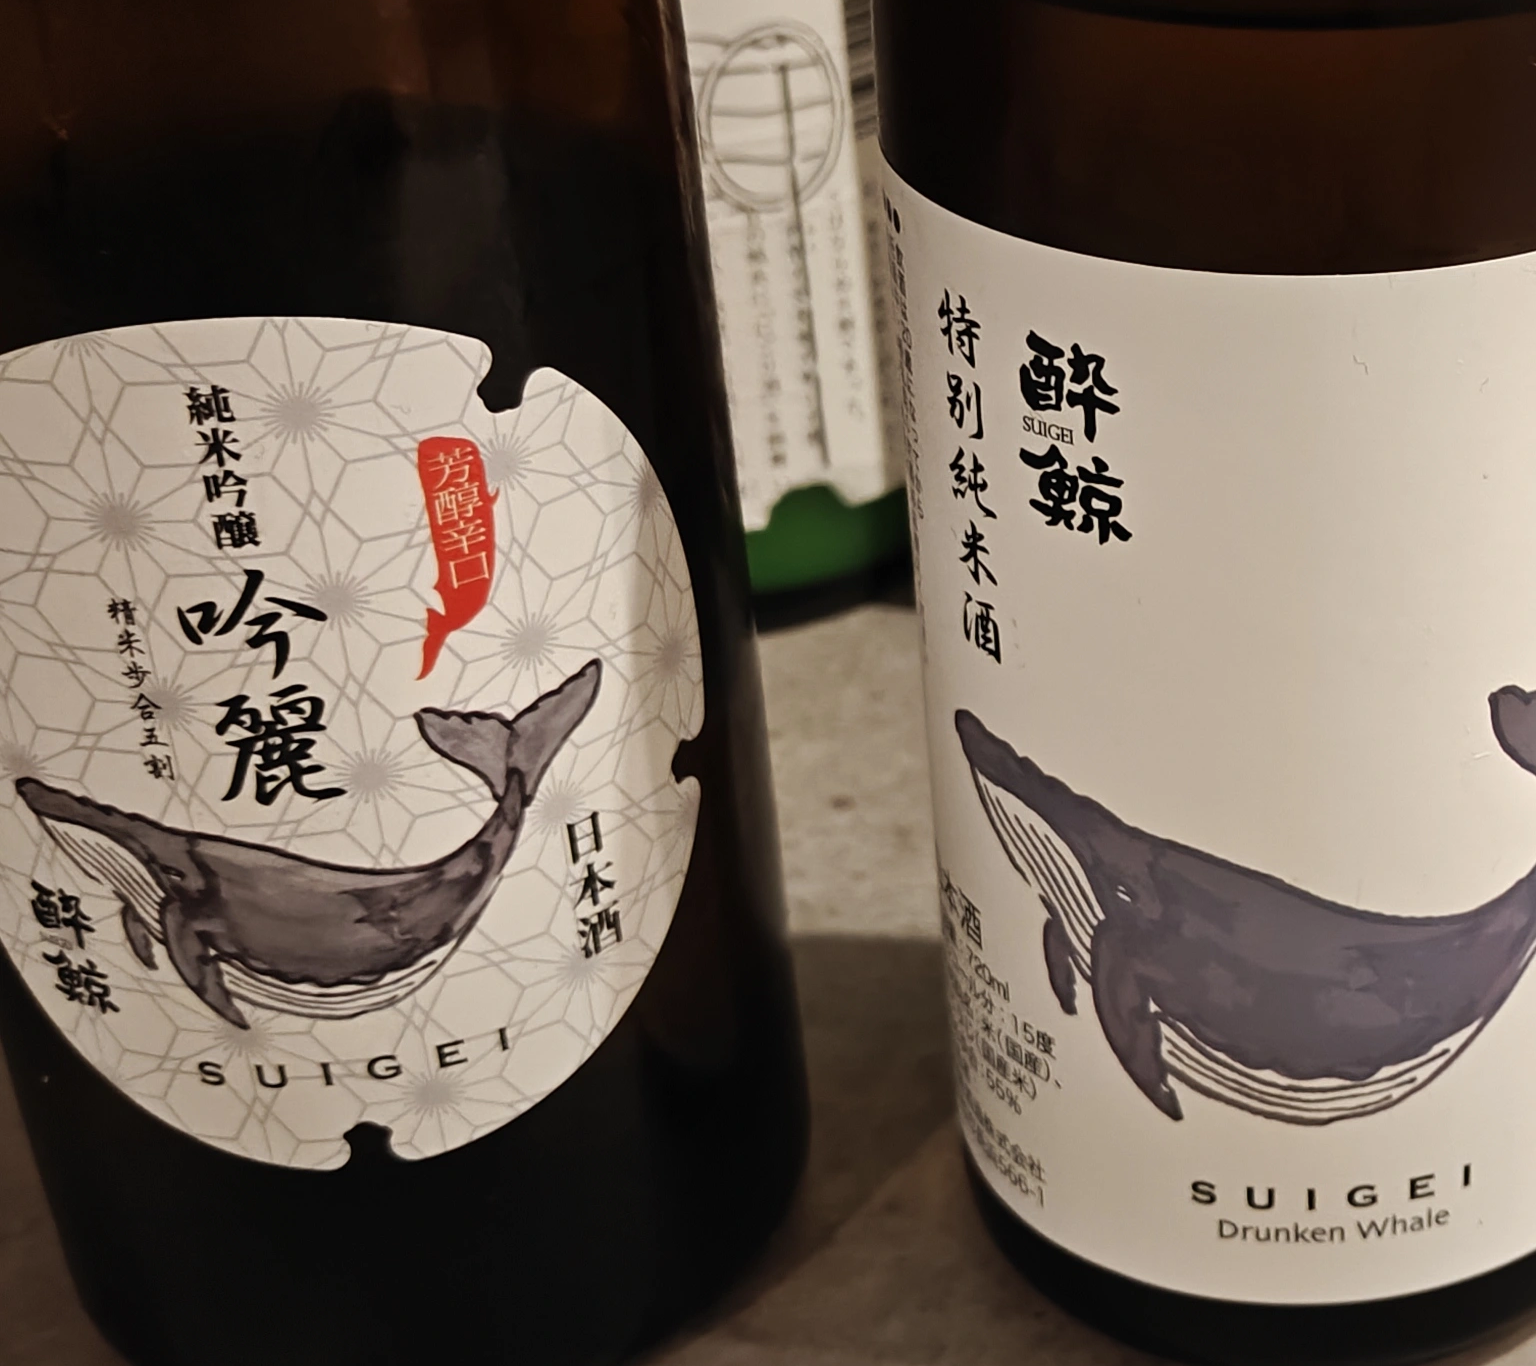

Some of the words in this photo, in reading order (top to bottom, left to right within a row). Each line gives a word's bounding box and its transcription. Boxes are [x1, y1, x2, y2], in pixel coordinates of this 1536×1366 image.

[182, 384, 261, 551] 純米吟醸
[937, 288, 1003, 667] 特別純米酒
[1017, 329, 1133, 546] 酔鯨
[1022, 415, 1075, 446] SUIGEI
[427, 447, 490, 589] 芳醇辛口
[107, 597, 175, 782] 精米歩合五割
[174, 566, 347, 807] 吟麗
[29, 878, 121, 1016] 酔鯨
[566, 811, 624, 960] 日本酒
[940, 868, 983, 952] 本酒
[197, 1027, 512, 1089] SUIGEI
[1189, 1162, 1474, 1210] SUIGEI
[1217, 1215, 1346, 1244] Drunken
[1354, 1203, 1451, 1241] Whale
